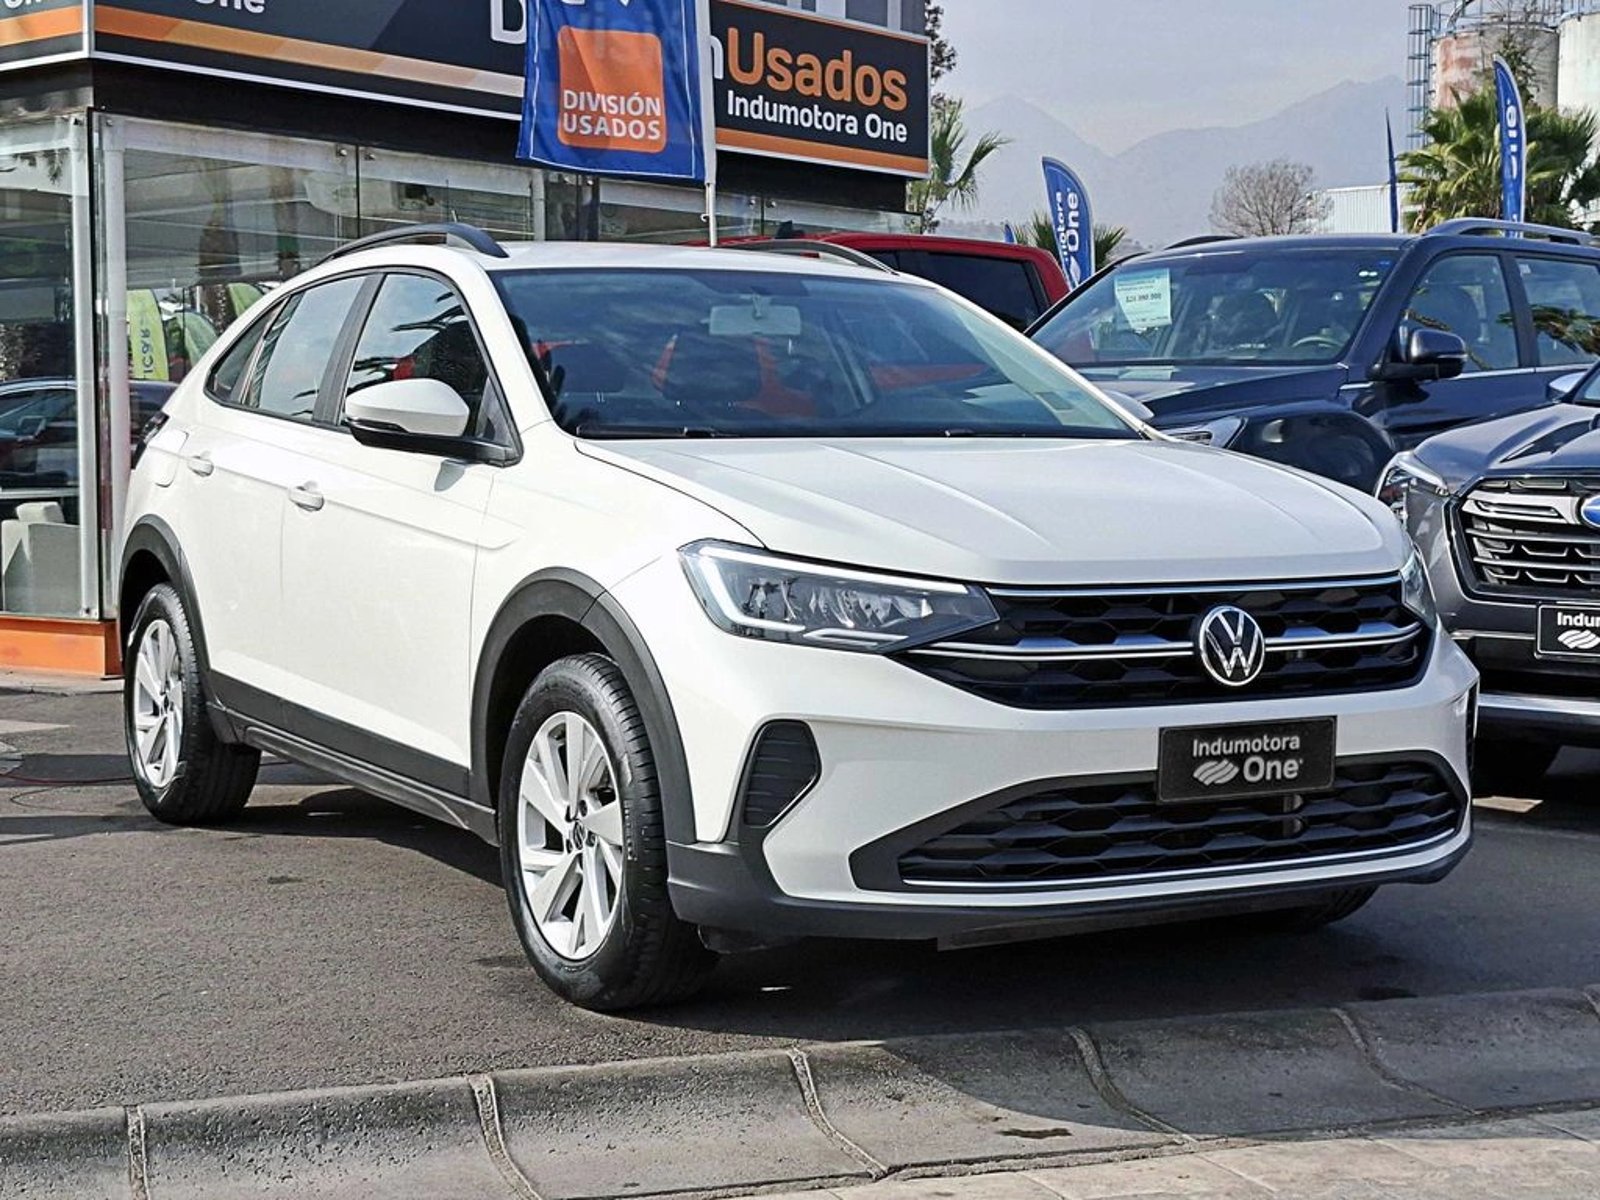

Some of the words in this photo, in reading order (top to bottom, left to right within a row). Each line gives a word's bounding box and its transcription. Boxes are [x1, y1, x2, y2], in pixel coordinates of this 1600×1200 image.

[563, 89, 661, 117] DIVISIÓN
[727, 90, 859, 136] Indumotora
[865, 113, 908, 143] One
[563, 115, 661, 140] USADOS
[1066, 192, 1080, 253] One
[1192, 734, 1301, 757] Indumotora
[1243, 756, 1299, 783] One
